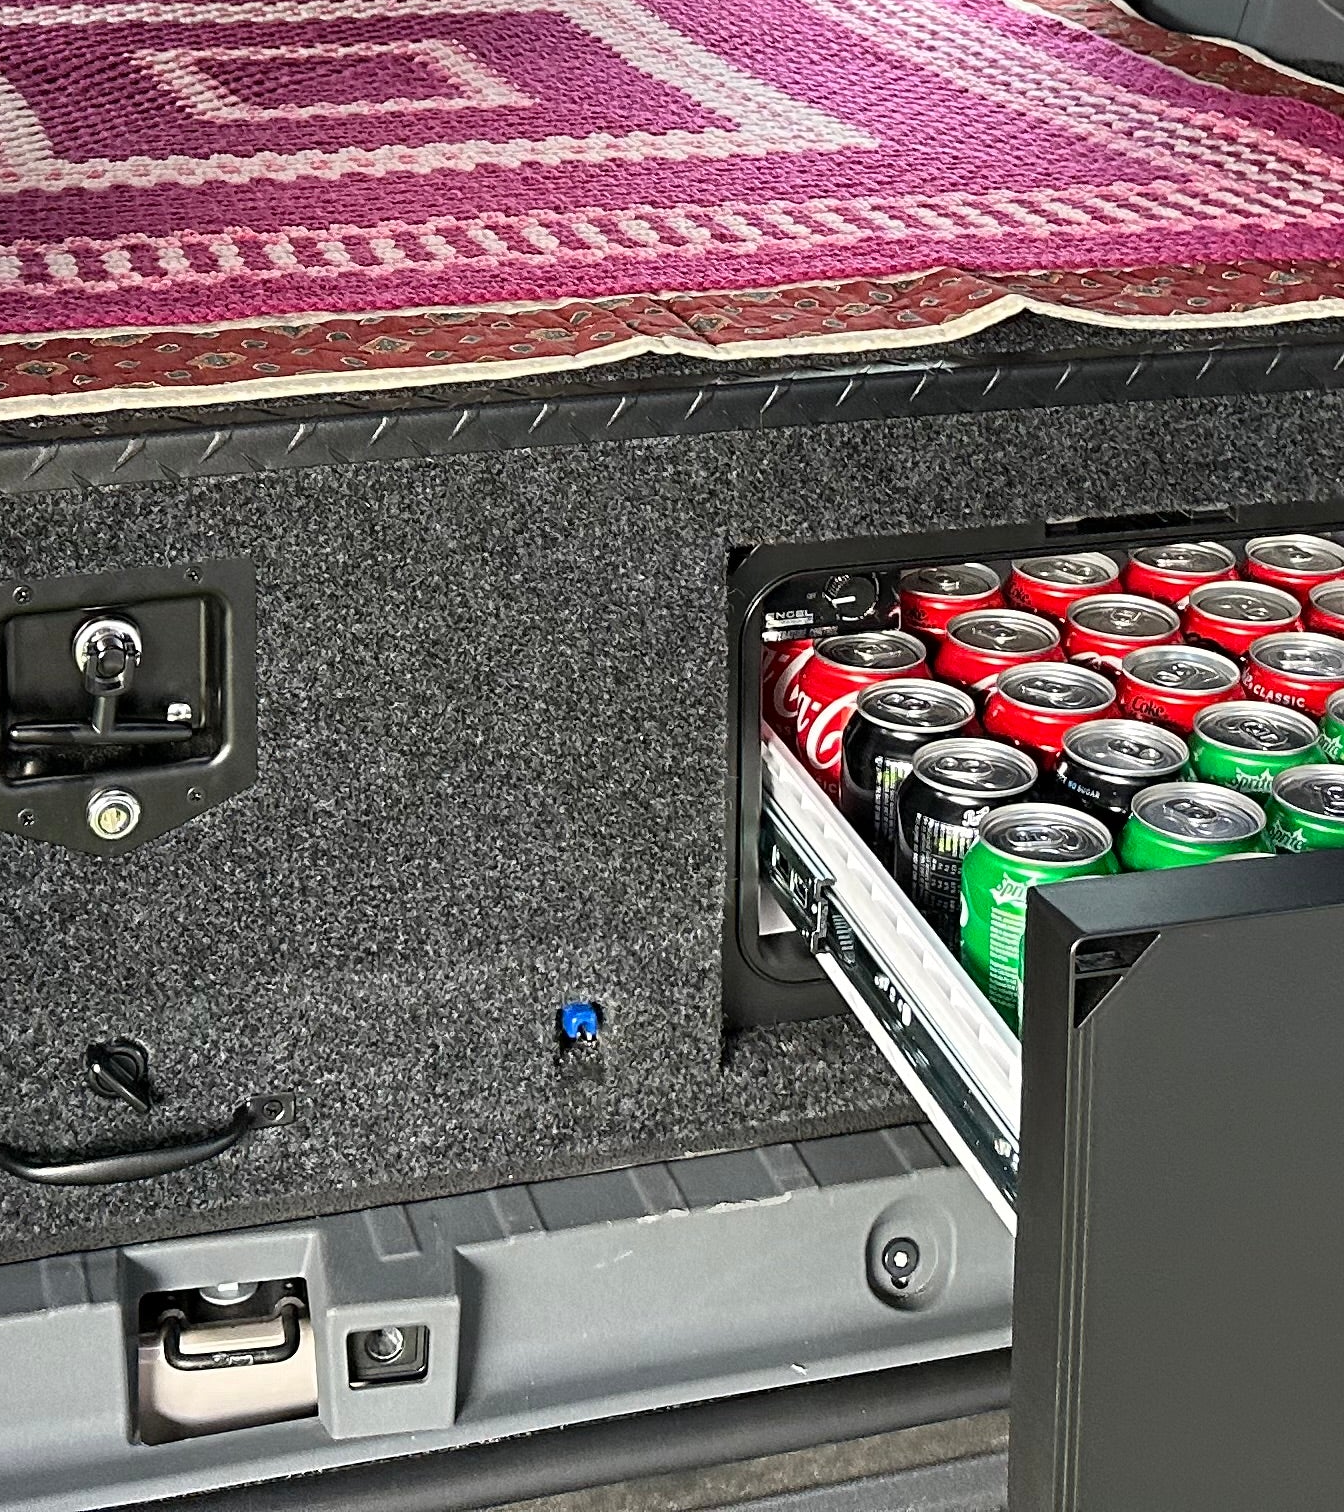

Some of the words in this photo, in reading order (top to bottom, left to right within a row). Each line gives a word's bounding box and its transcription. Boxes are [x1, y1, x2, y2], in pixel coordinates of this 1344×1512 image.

[1131, 695, 1165, 718] Coke
[1253, 683, 1306, 708] CLASSIC
[1076, 784, 1101, 799] SUGAR
